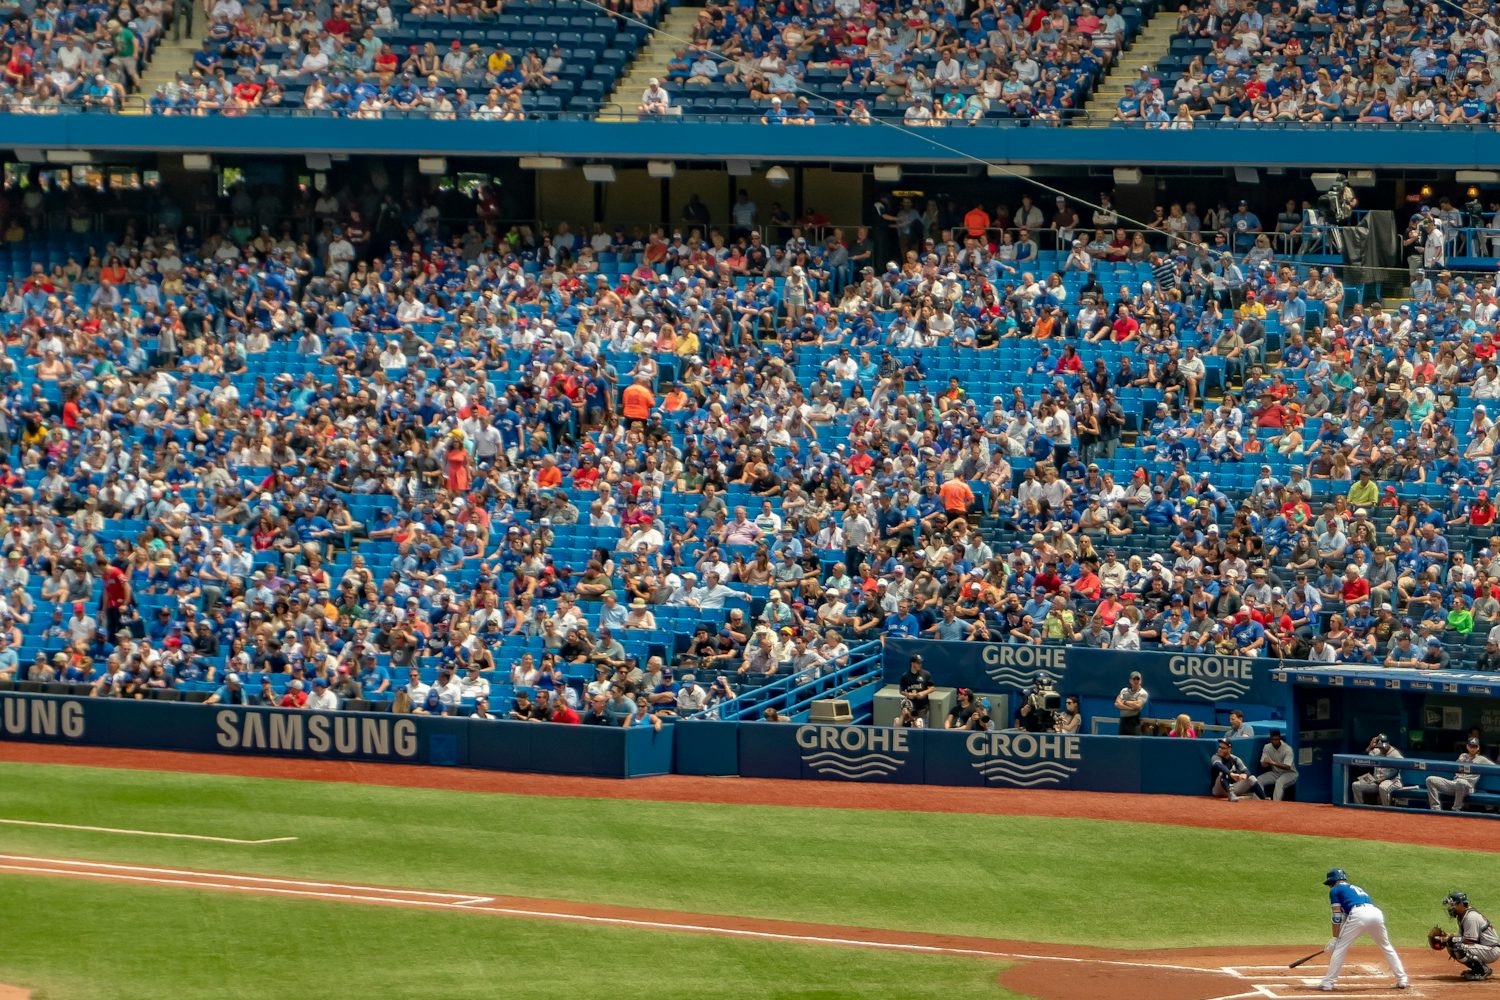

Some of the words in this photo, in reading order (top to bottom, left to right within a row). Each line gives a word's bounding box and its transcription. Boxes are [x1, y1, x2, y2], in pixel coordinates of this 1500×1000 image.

[982, 645, 1066, 668] GROHE
[1169, 655, 1253, 679] GROHE
[0, 697, 84, 737] UNG
[216, 710, 418, 757] SAMSUNG
[796, 725, 909, 751] GROHE
[966, 733, 1081, 759] GROHE
